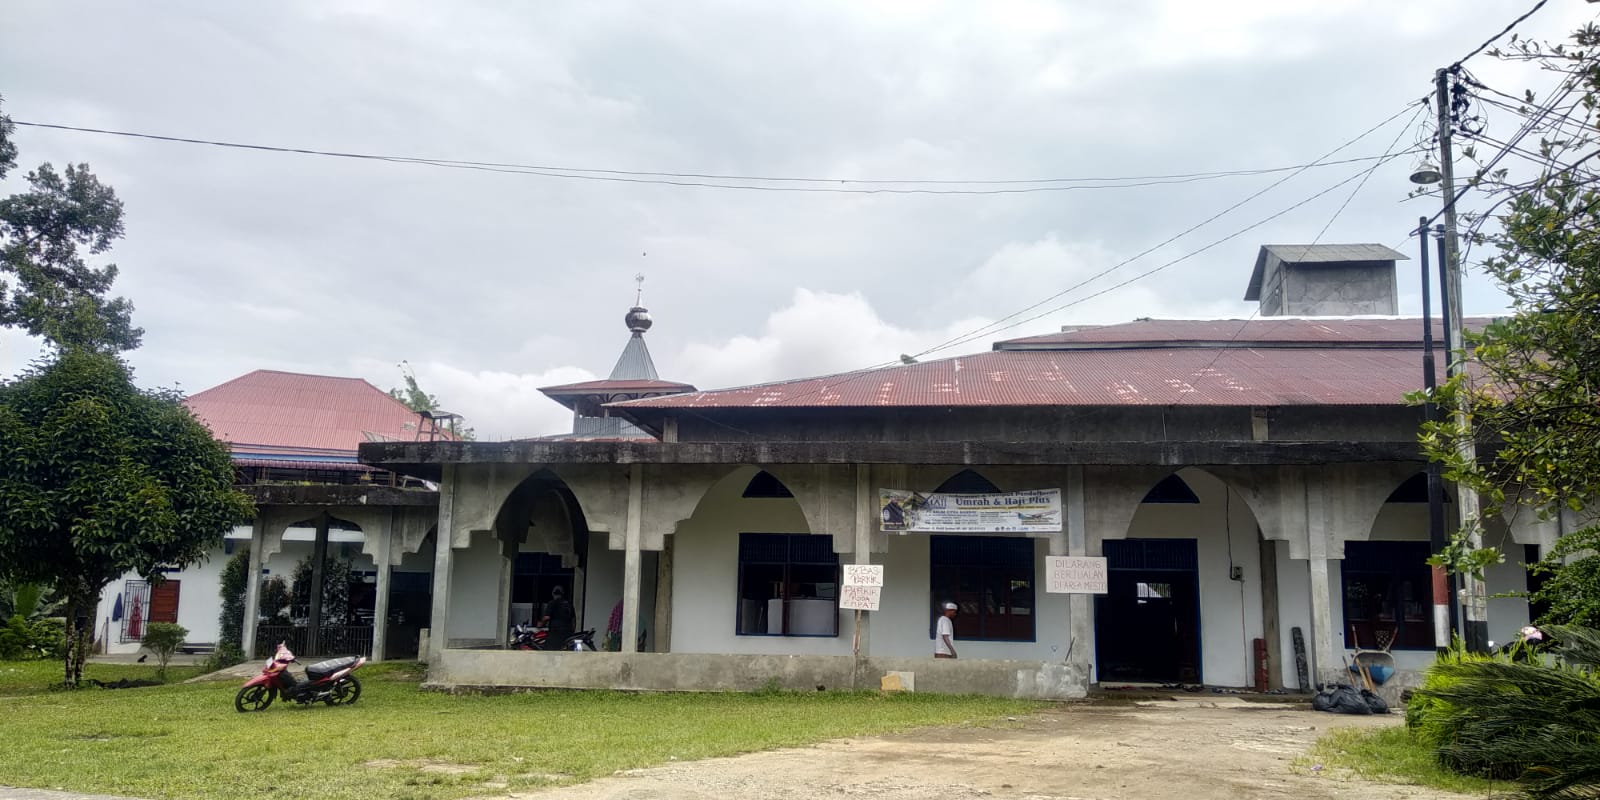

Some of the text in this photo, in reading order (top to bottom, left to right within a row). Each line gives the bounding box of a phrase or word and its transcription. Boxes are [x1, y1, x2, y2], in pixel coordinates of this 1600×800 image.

[955, 497, 990, 506] Umrah
[994, 498, 1003, 506] &
[1055, 559, 1102, 569] DILARANG
[1054, 569, 1104, 579] BERJUALAN
